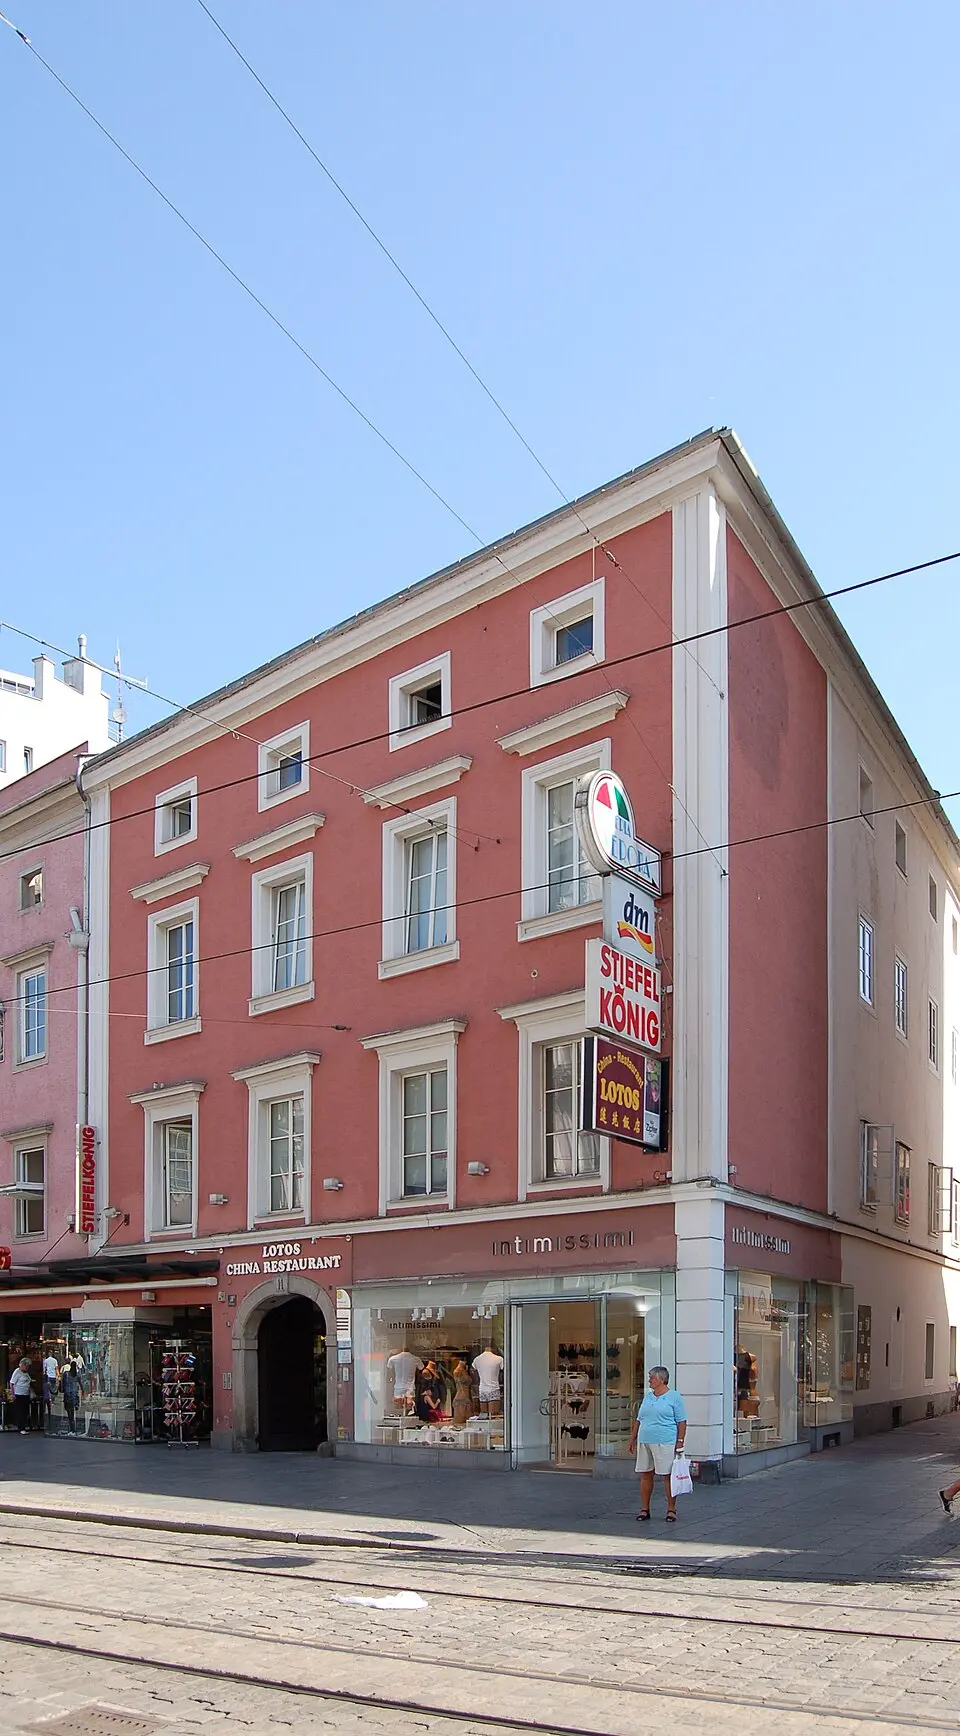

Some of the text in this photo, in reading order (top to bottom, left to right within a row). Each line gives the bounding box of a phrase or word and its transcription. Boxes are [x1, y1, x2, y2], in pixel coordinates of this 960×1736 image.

[623, 892, 649, 934] dm
[600, 944, 660, 1003] STIEFEL
[597, 1054, 613, 1074] China
[617, 1050, 644, 1089] Restaurant
[600, 1077, 640, 1111] LOTOS
[261, 1242, 301, 1258] LOTOS
[492, 1230, 635, 1256] intimissimi
[226, 1254, 342, 1276] CHINA RESTAURANT
[389, 1321, 441, 1330] intimissimi
